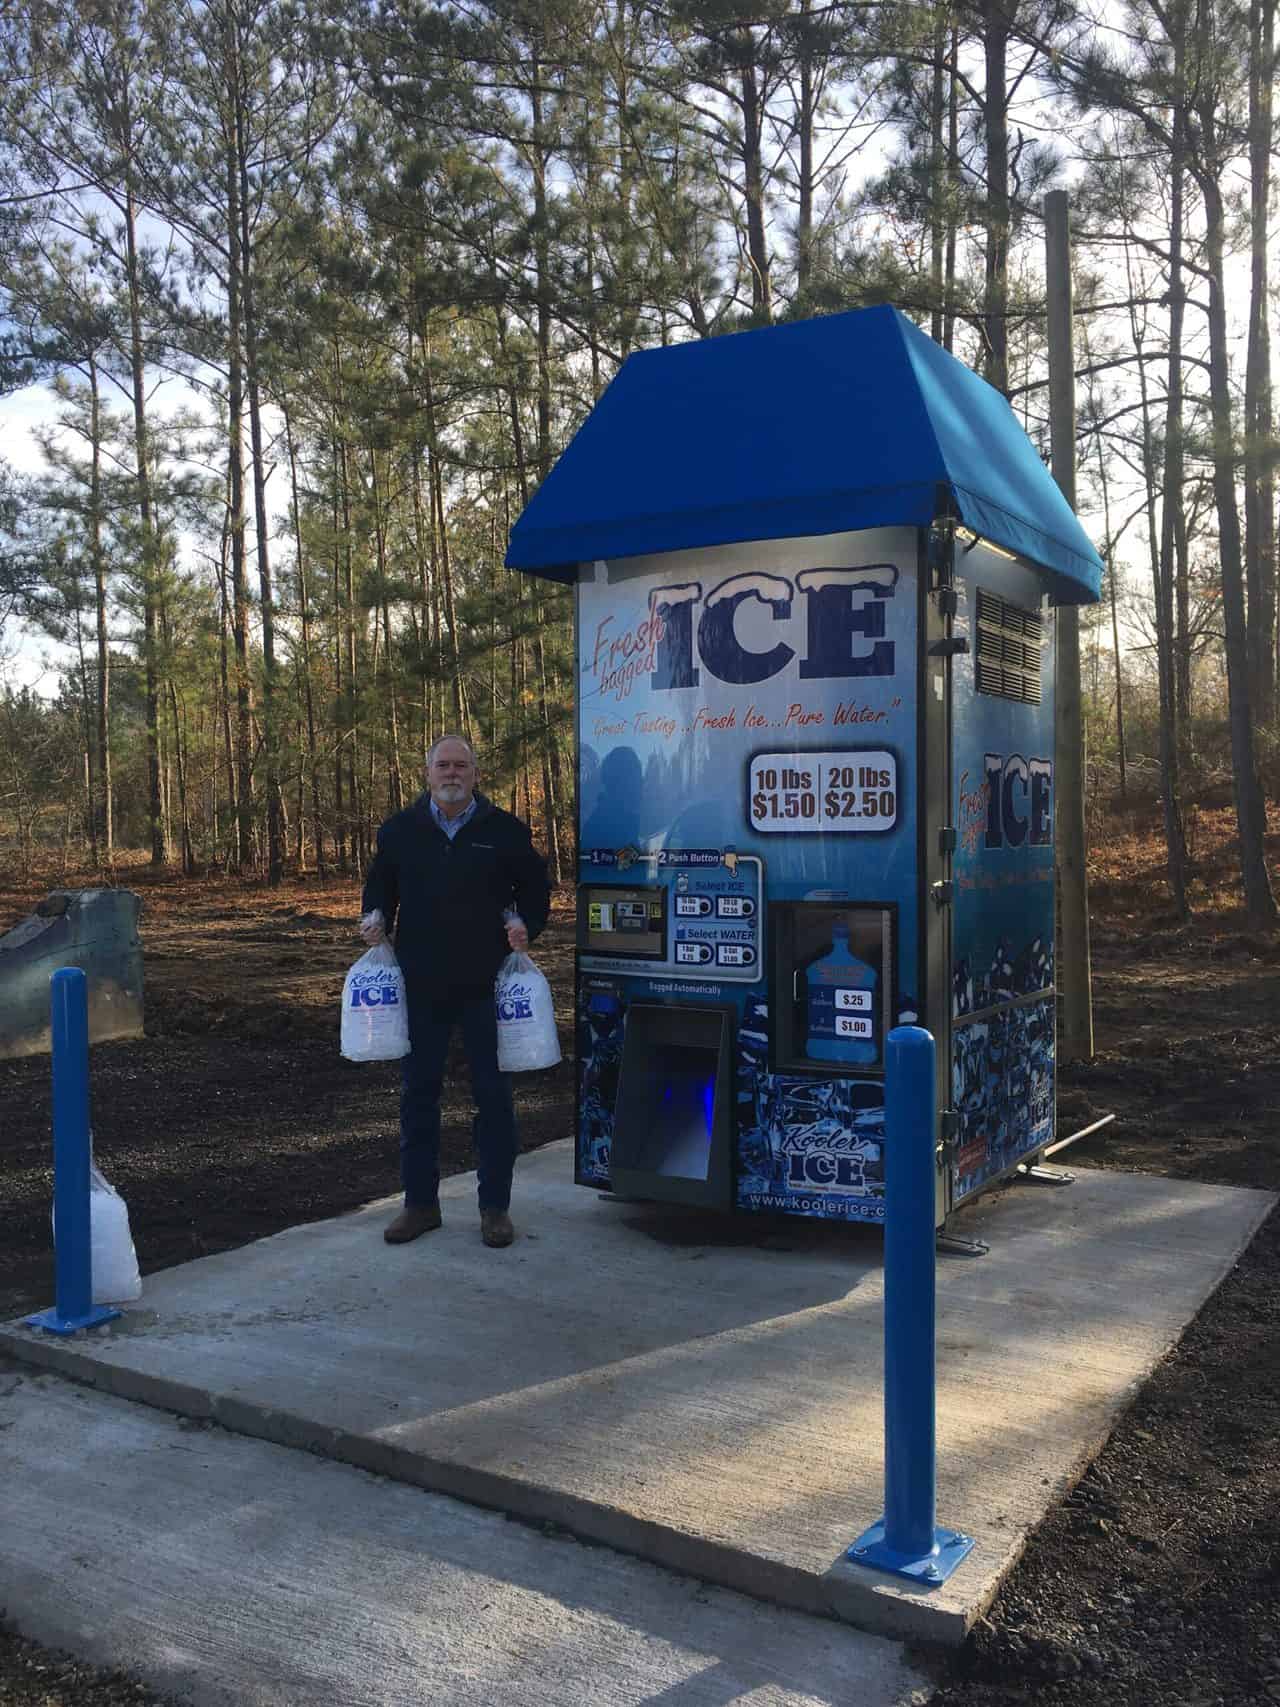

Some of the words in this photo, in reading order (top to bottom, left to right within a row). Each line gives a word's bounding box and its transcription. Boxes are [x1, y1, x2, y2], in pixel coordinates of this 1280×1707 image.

[592, 594, 666, 677] Fresh
[648, 564, 899, 690] ICE
[599, 654, 656, 701] bagged
[756, 769, 777, 790] 10
[781, 769, 812, 790] lbs
[828, 767, 854, 788] 20
[859, 767, 891, 788] lbs
[752, 792, 815, 820] $1.50
[825, 790, 895, 819] $2.50
[984, 752, 1052, 850] ICE
[658, 851, 667, 864] 2
[668, 854, 689, 864] Push
[690, 854, 719, 864] Button
[687, 929, 718, 940] Select
[720, 930, 754, 941] WATER
[350, 985, 400, 1008] ICE
[673, 983, 721, 995] Automatically
[841, 1020, 866, 1033] $1.00
[782, 1124, 873, 1153] Kooler
[788, 1151, 866, 1188] ICE
